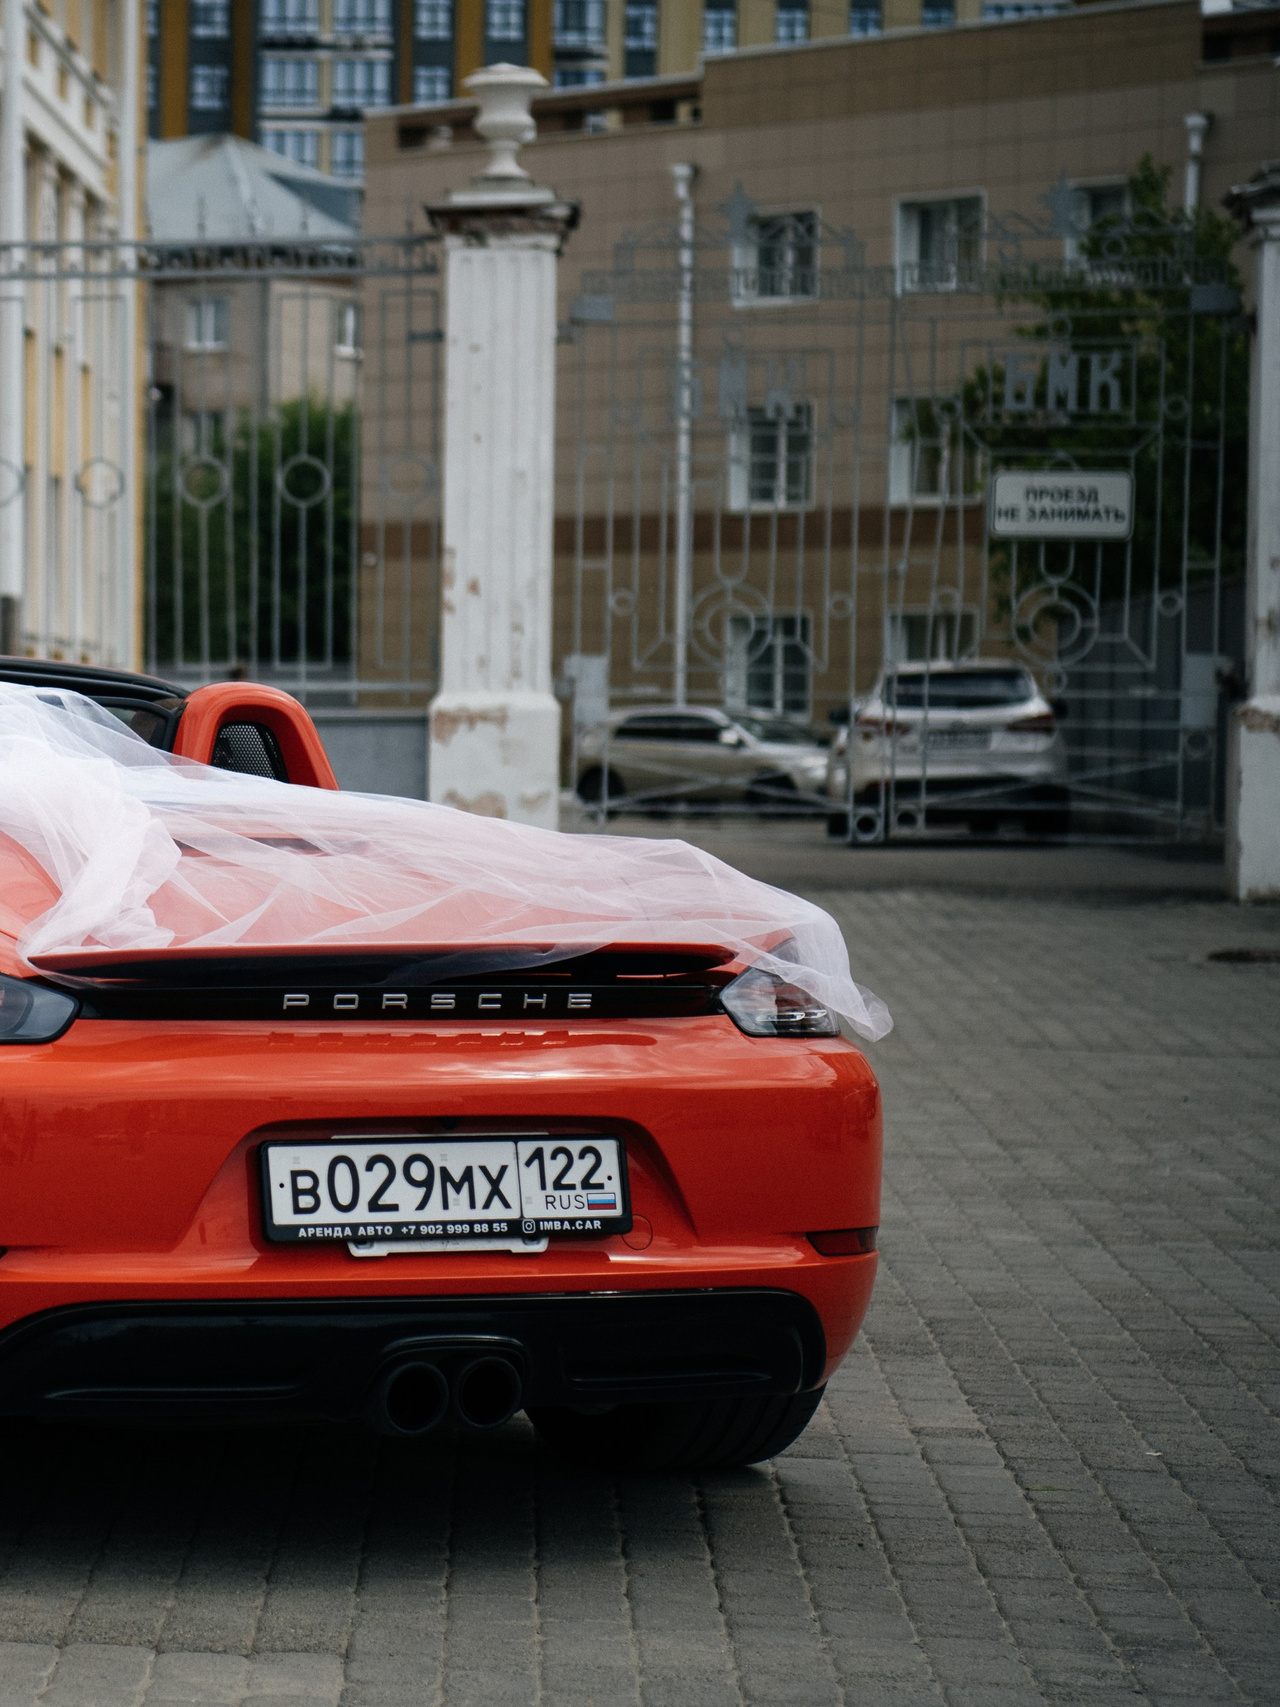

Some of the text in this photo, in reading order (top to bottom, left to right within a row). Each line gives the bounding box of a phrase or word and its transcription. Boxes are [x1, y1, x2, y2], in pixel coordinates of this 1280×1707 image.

[1025, 486, 1099, 504] ПРОЕЗД
[997, 505, 1126, 523] НЕ ЗАНИМАТЬ
[282, 993, 593, 1010] PORSCHE
[524, 1145, 606, 1191] 122
[544, 1194, 586, 1211] RUS
[298, 1222, 508, 1239] АРЕНДА АВТО +7 902 999 88 55
[539, 1219, 602, 1231] IMBA.CAR
